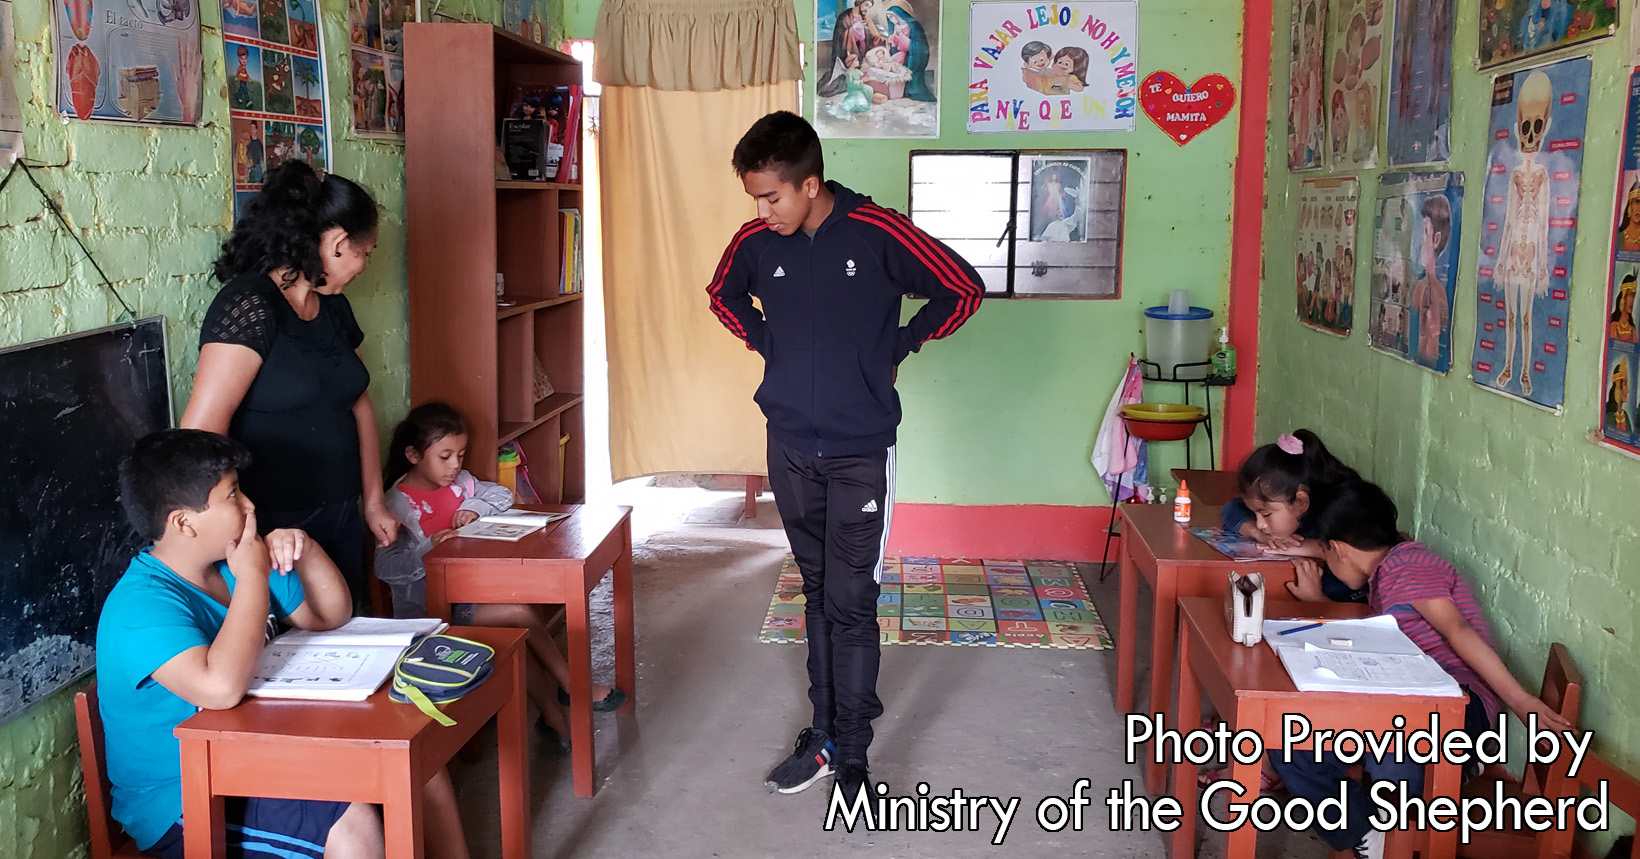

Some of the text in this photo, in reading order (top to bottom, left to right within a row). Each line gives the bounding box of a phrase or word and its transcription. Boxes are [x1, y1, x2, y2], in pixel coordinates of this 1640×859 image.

[106, 9, 144, 30] El tacto
[1027, 4, 1080, 30] LEJOS
[973, 19, 1022, 69] VIAJAR
[1113, 62, 1137, 120] MEJOR
[1149, 83, 1162, 94] TE
[1172, 90, 1209, 103] QUIERO
[969, 78, 991, 123] PARA
[1039, 99, 1073, 129] QUE
[1083, 94, 1106, 119] UN
[509, 122, 531, 130] Escolar
[1007, 620, 1038, 632] T
